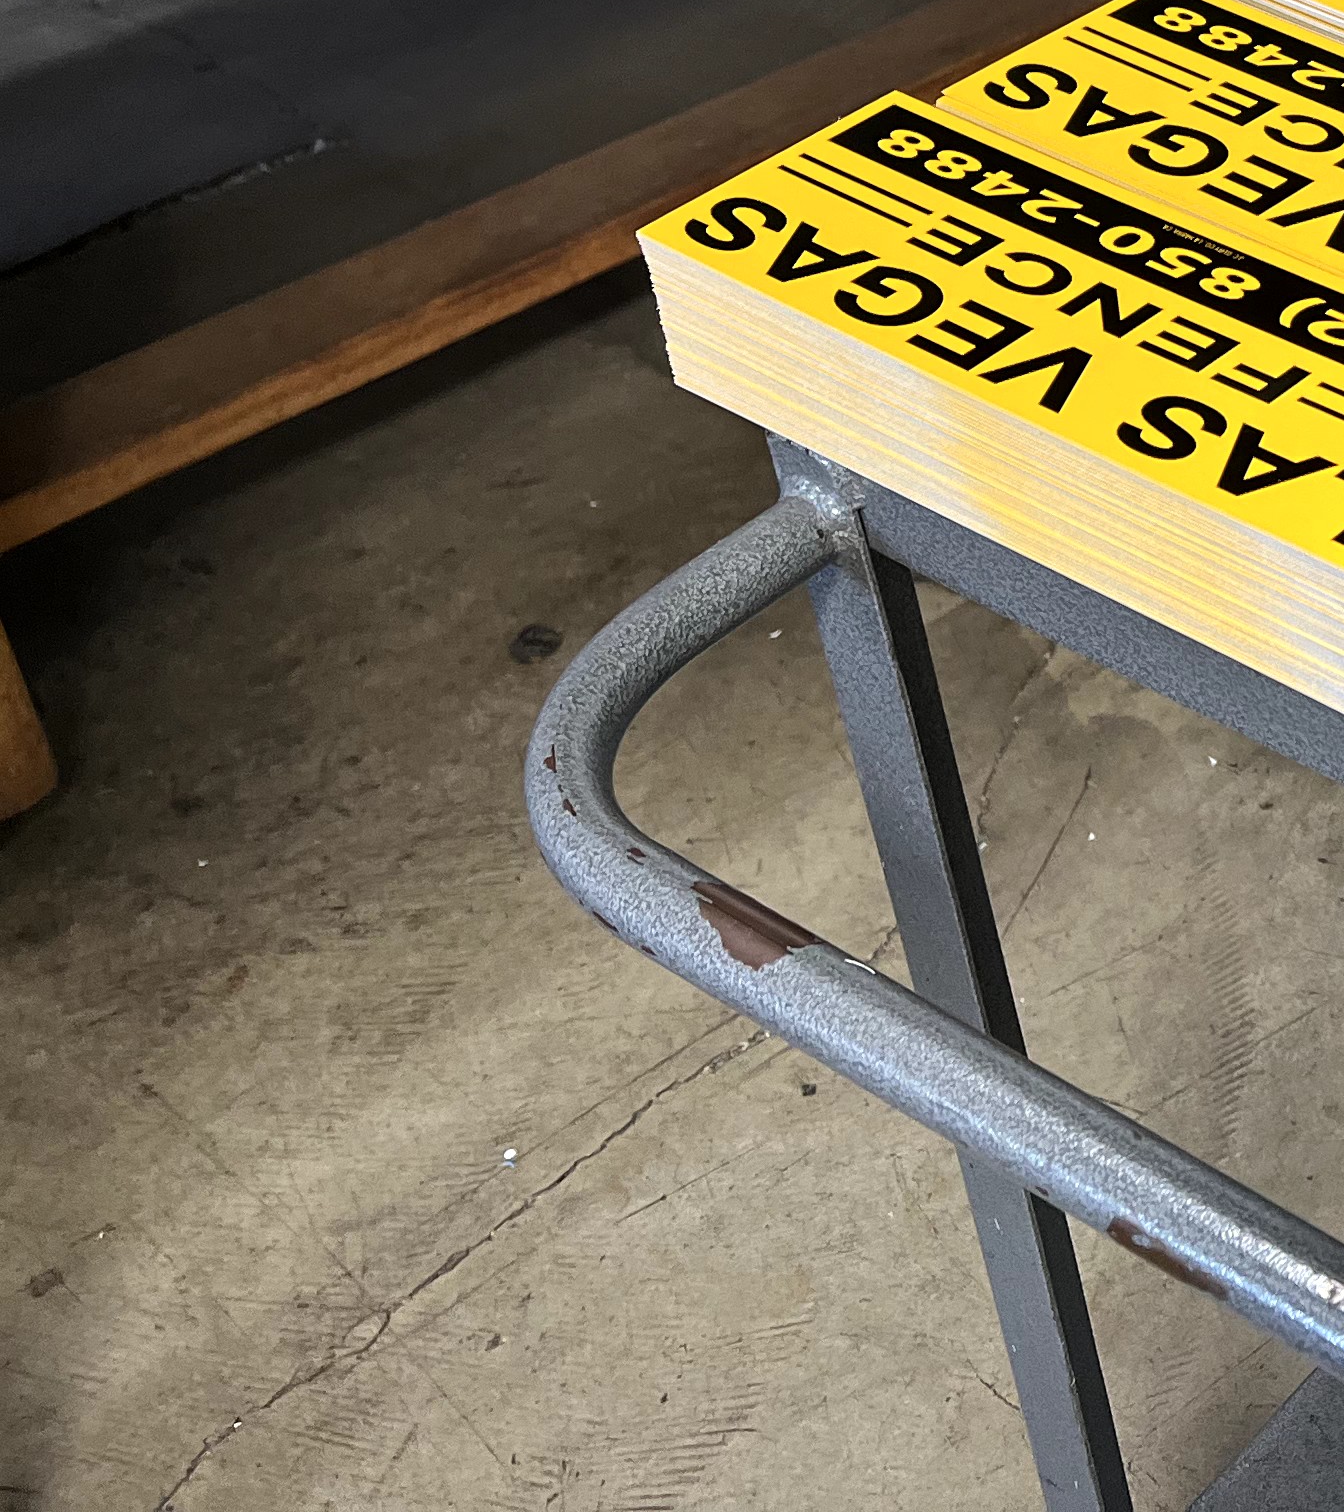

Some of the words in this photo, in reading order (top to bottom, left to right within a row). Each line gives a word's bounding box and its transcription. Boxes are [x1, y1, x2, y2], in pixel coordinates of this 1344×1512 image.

[685, 198, 1091, 412] VEGAS
[878, 130, 1259, 298] 850-2488
[908, 216, 1309, 402] FENCE
